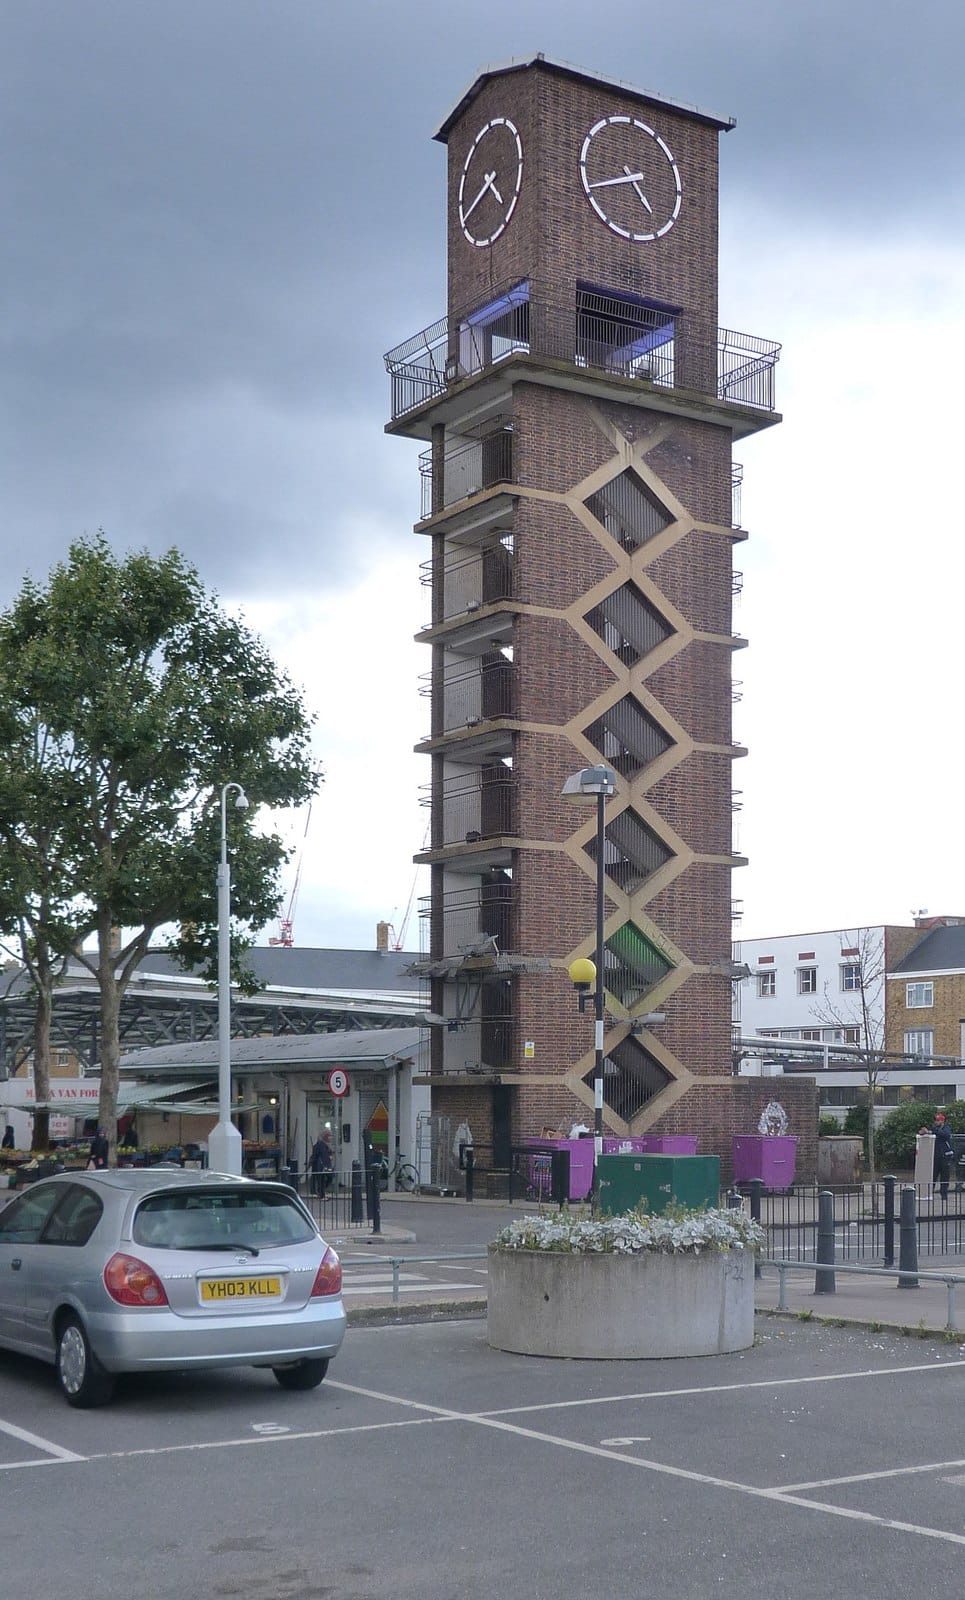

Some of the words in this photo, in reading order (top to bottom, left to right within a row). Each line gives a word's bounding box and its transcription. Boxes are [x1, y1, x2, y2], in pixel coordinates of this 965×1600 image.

[335, 1076, 342, 1088] 5
[58, 1089, 77, 1098] VAN
[80, 1089, 98, 1098] FOR
[208, 1282, 245, 1297] YH03
[249, 1281, 275, 1295] KLL
